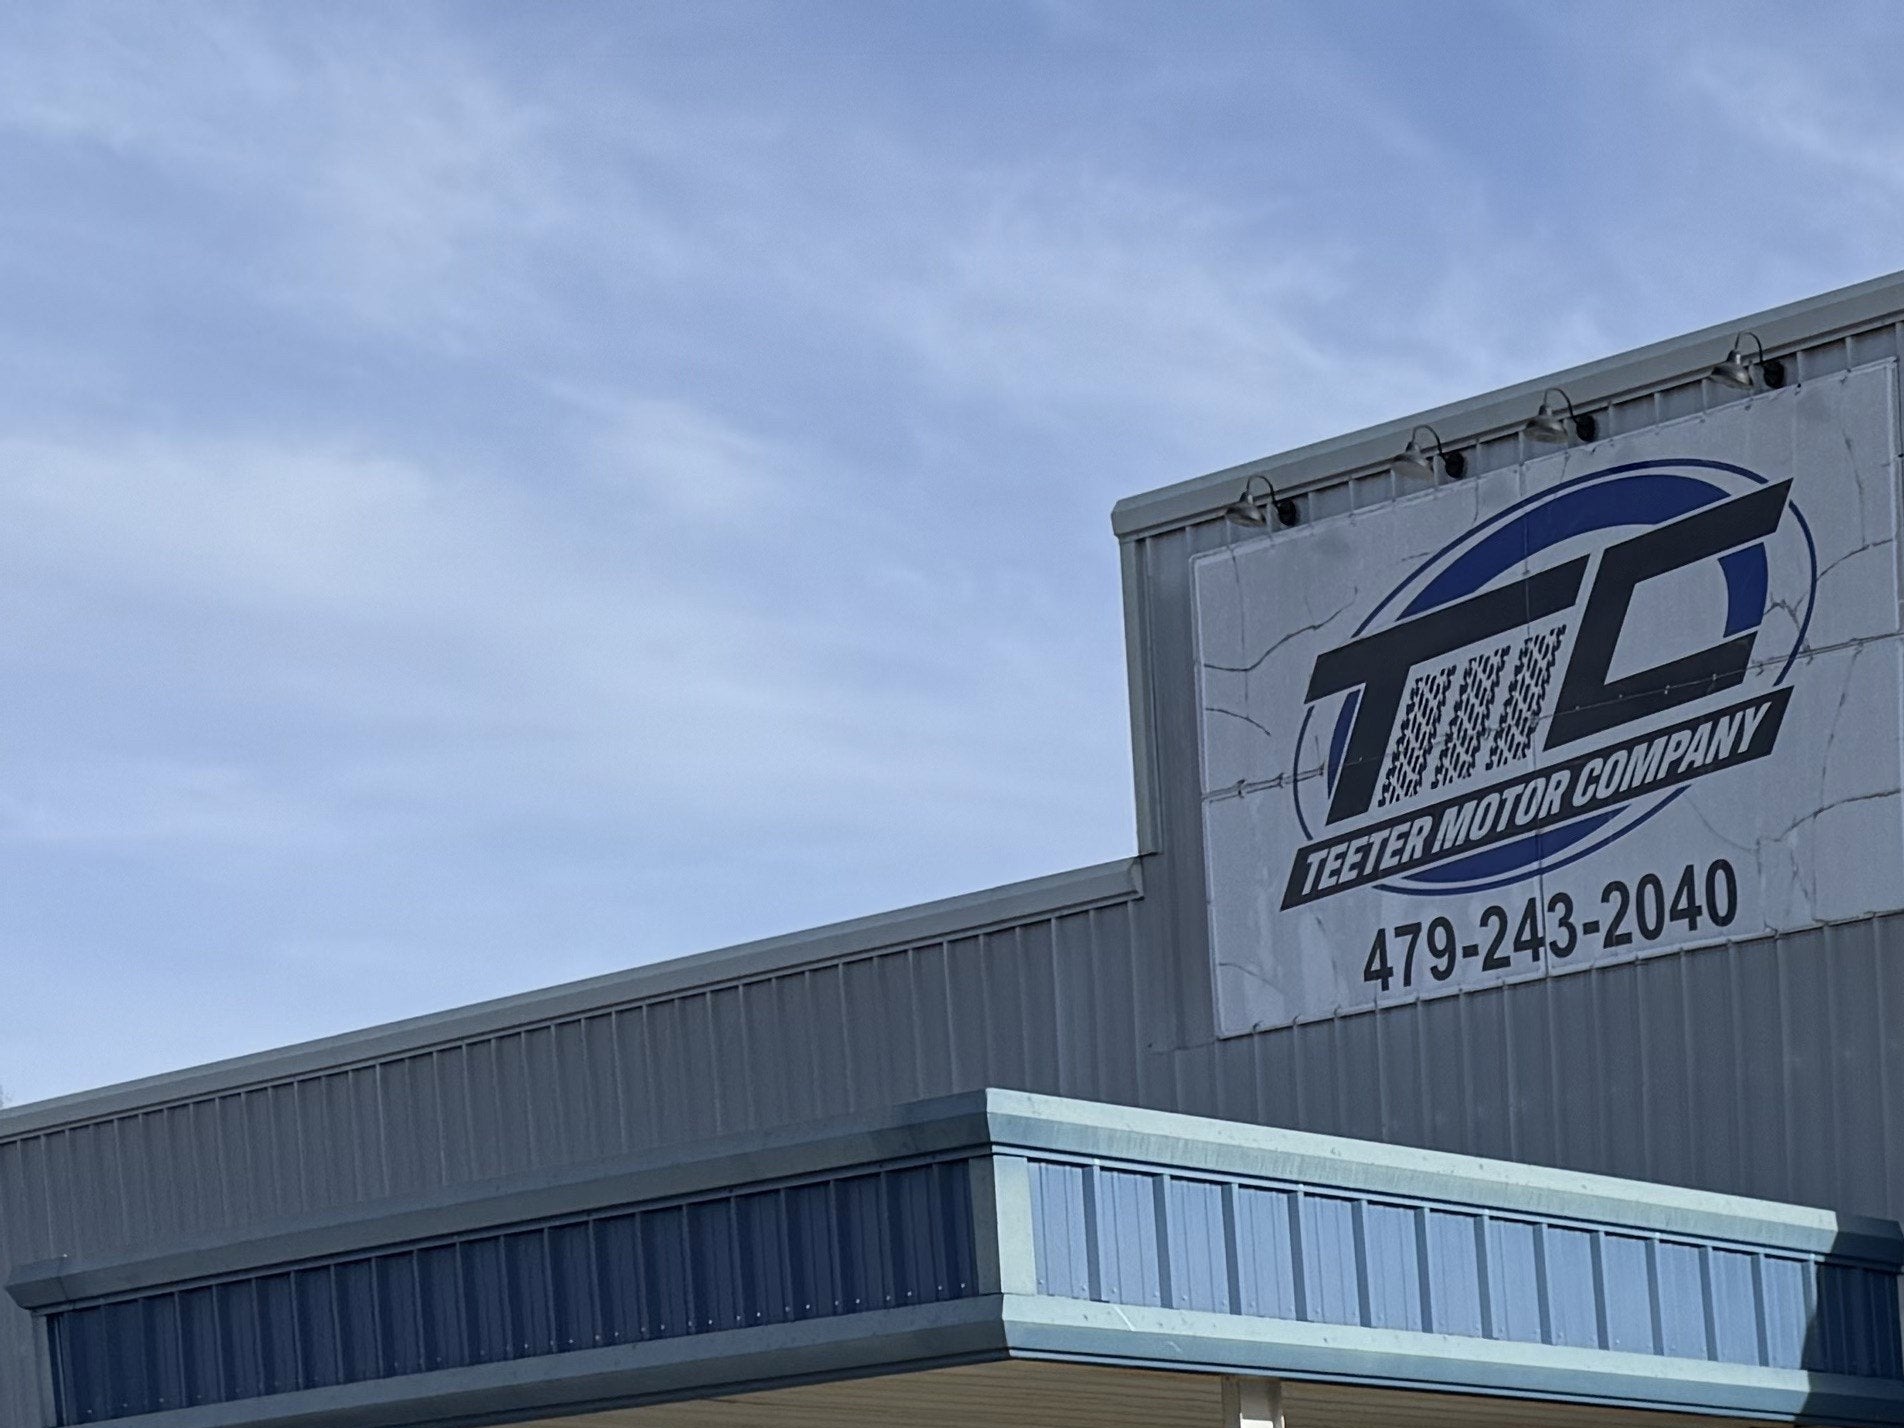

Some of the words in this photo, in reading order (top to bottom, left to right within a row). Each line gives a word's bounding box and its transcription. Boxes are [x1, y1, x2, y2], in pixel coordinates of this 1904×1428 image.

[1301, 815, 1433, 896] TEETER
[1432, 775, 1570, 854] MOTOR
[1570, 701, 1772, 808] COMPANY
[1363, 859, 1739, 992] 479-243-2040
